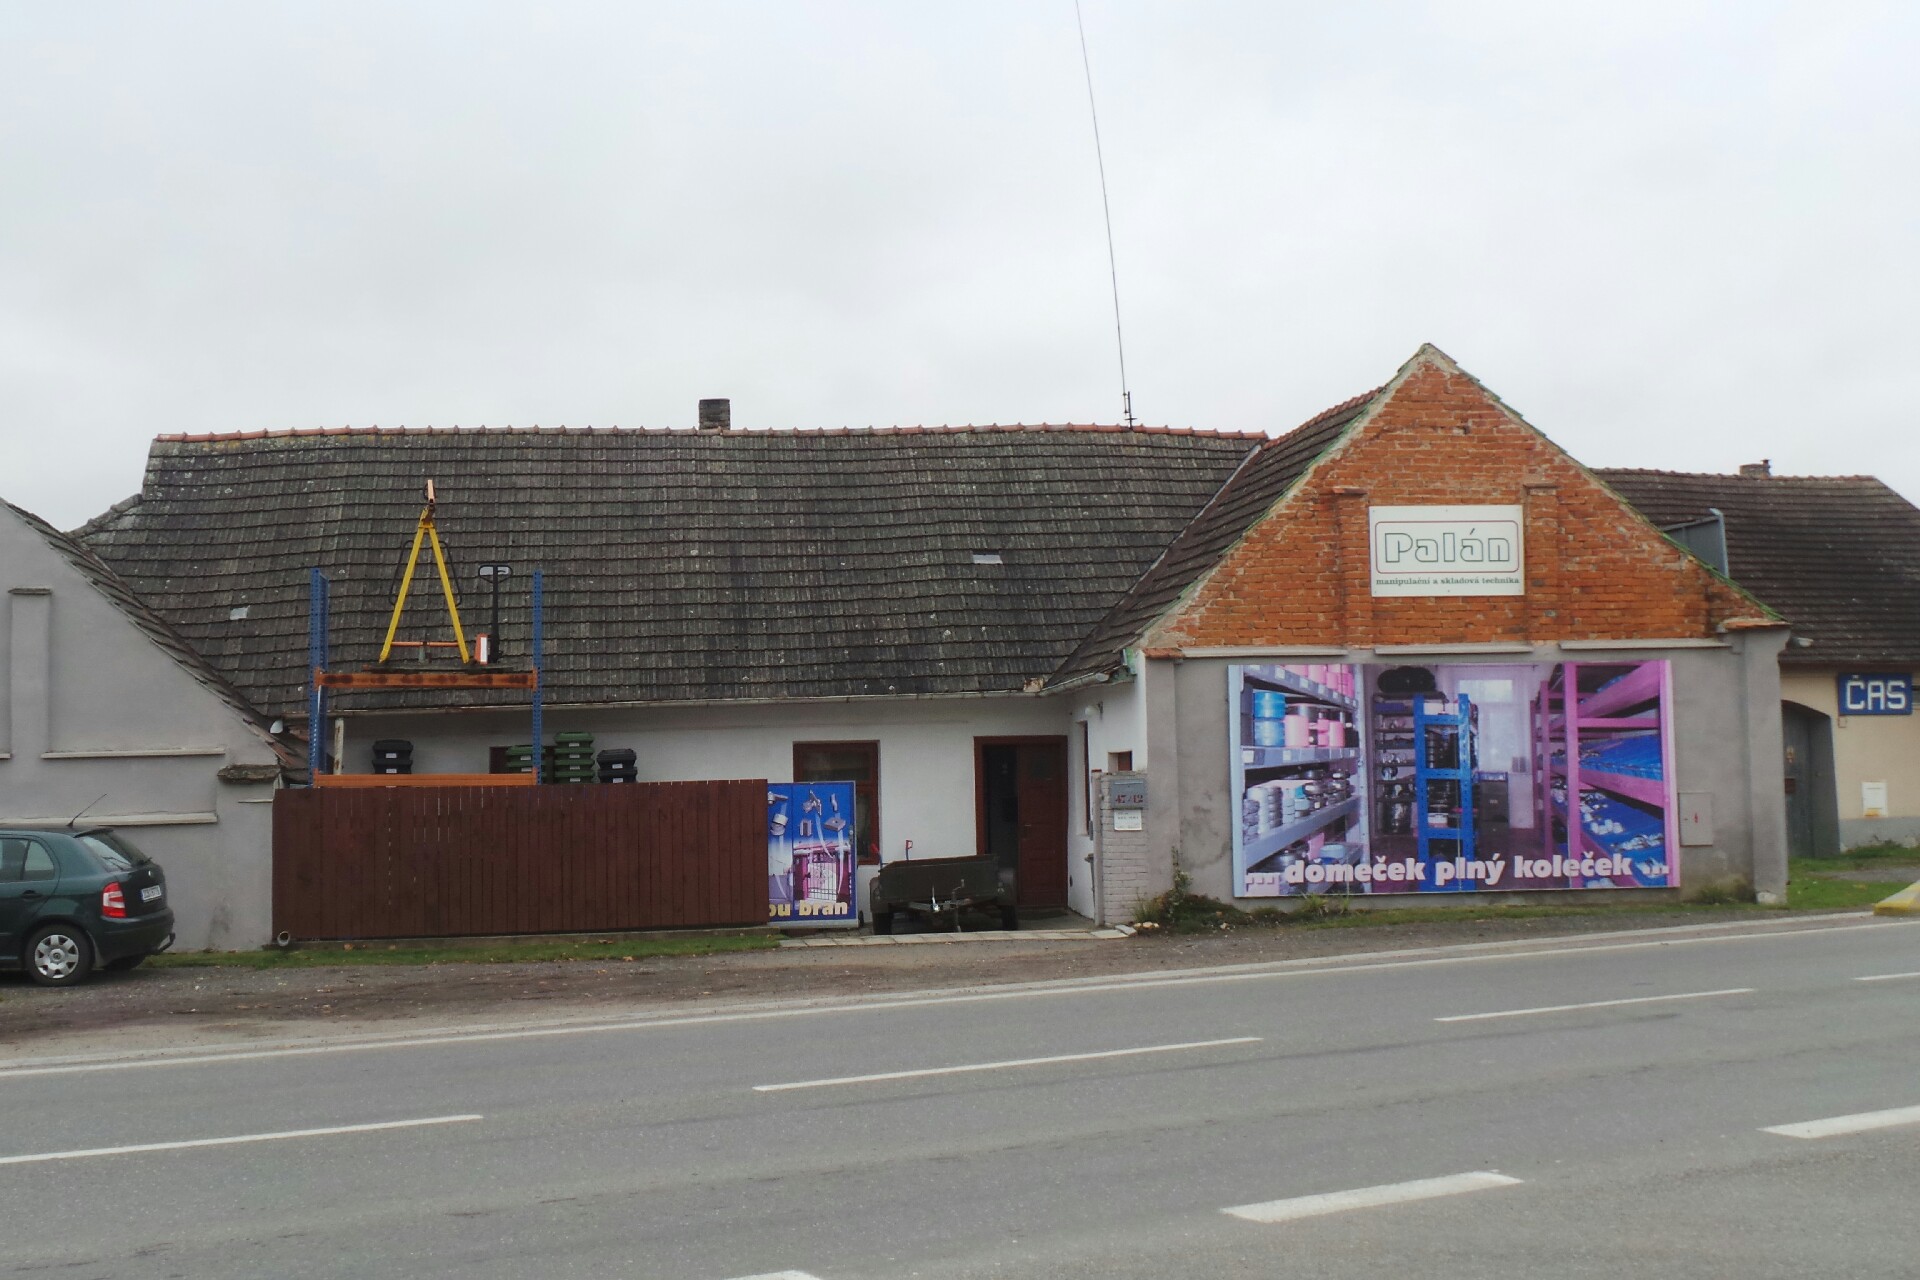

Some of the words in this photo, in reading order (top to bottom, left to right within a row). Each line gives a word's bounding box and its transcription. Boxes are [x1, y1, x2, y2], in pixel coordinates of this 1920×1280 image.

[1384, 527, 1510, 563] Palán
[1376, 577, 1430, 586] manipulační
[1440, 577, 1480, 585] skladová
[1285, 855, 1426, 884] domeček
[1434, 853, 1505, 886] plný
[1514, 851, 1632, 878] koleček
[798, 899, 848, 916] bran
